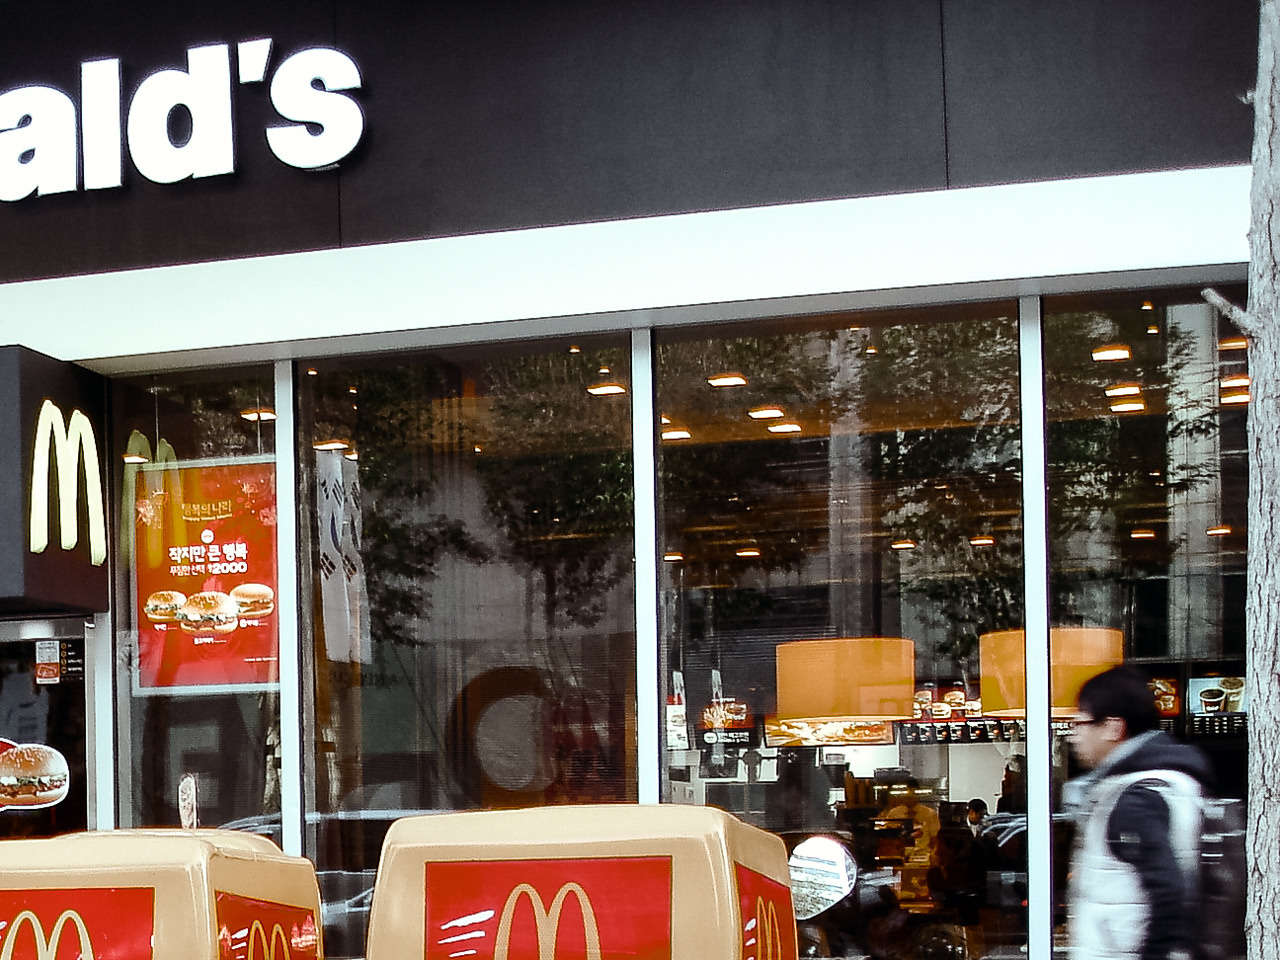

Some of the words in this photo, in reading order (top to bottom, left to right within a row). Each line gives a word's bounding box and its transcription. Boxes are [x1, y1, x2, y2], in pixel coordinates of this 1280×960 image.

[169, 546, 206, 564] 작지만
[207, 545, 221, 561] 큰
[222, 543, 248, 561] 행복
